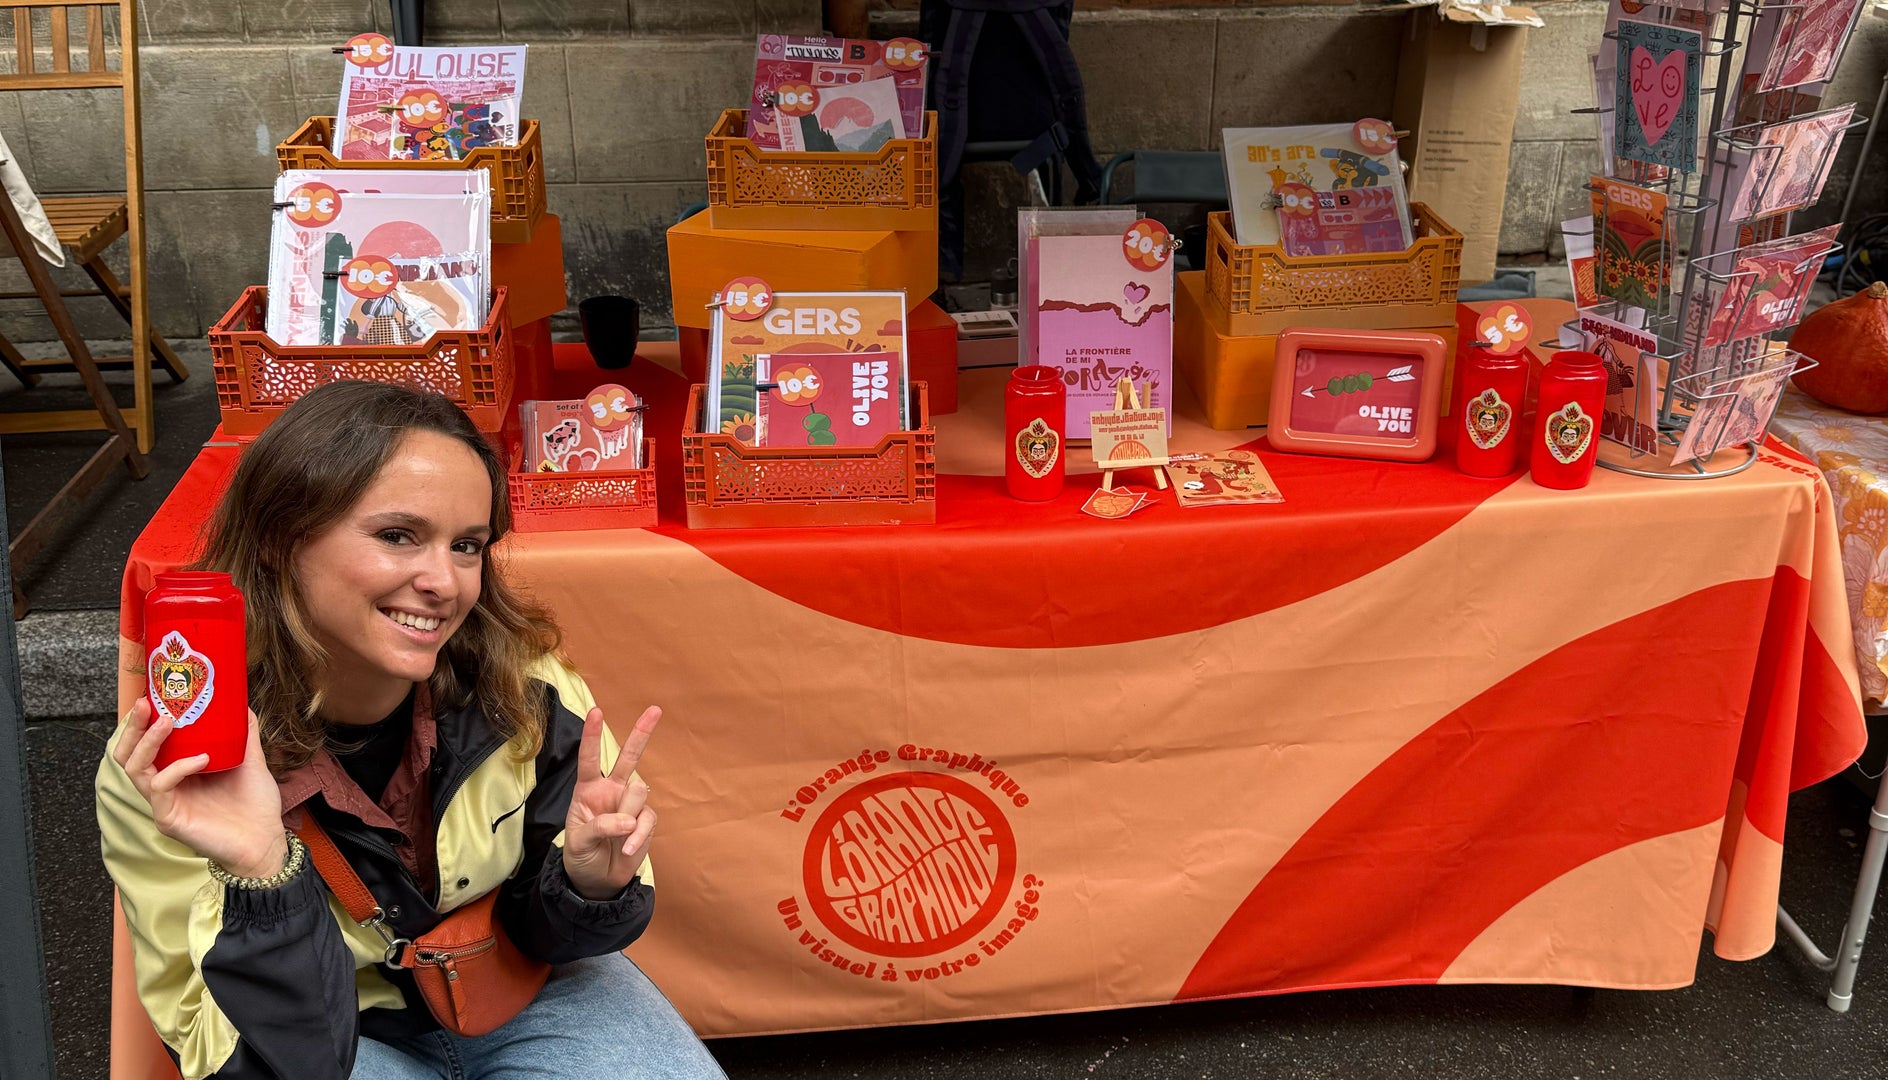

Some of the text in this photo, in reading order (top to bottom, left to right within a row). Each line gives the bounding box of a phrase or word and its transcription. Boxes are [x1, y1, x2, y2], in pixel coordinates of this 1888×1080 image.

[804, 36, 827, 44] Hello
[851, 45, 866, 60] B
[1339, 195, 1351, 206] B
[1606, 184, 1653, 211] GERS
[763, 307, 862, 335] GERS
[1079, 346, 1131, 355] FRONTIÈRE
[1065, 356, 1078, 364] DE
[871, 360, 889, 402] YOU
[852, 361, 870, 427] OLIVE
[1358, 405, 1413, 420] OLIVE
[1377, 418, 1411, 433] YOU
[780, 743, 1030, 823] L'Orange Graphique
[777, 873, 1044, 982] Un visuel à votre image?
